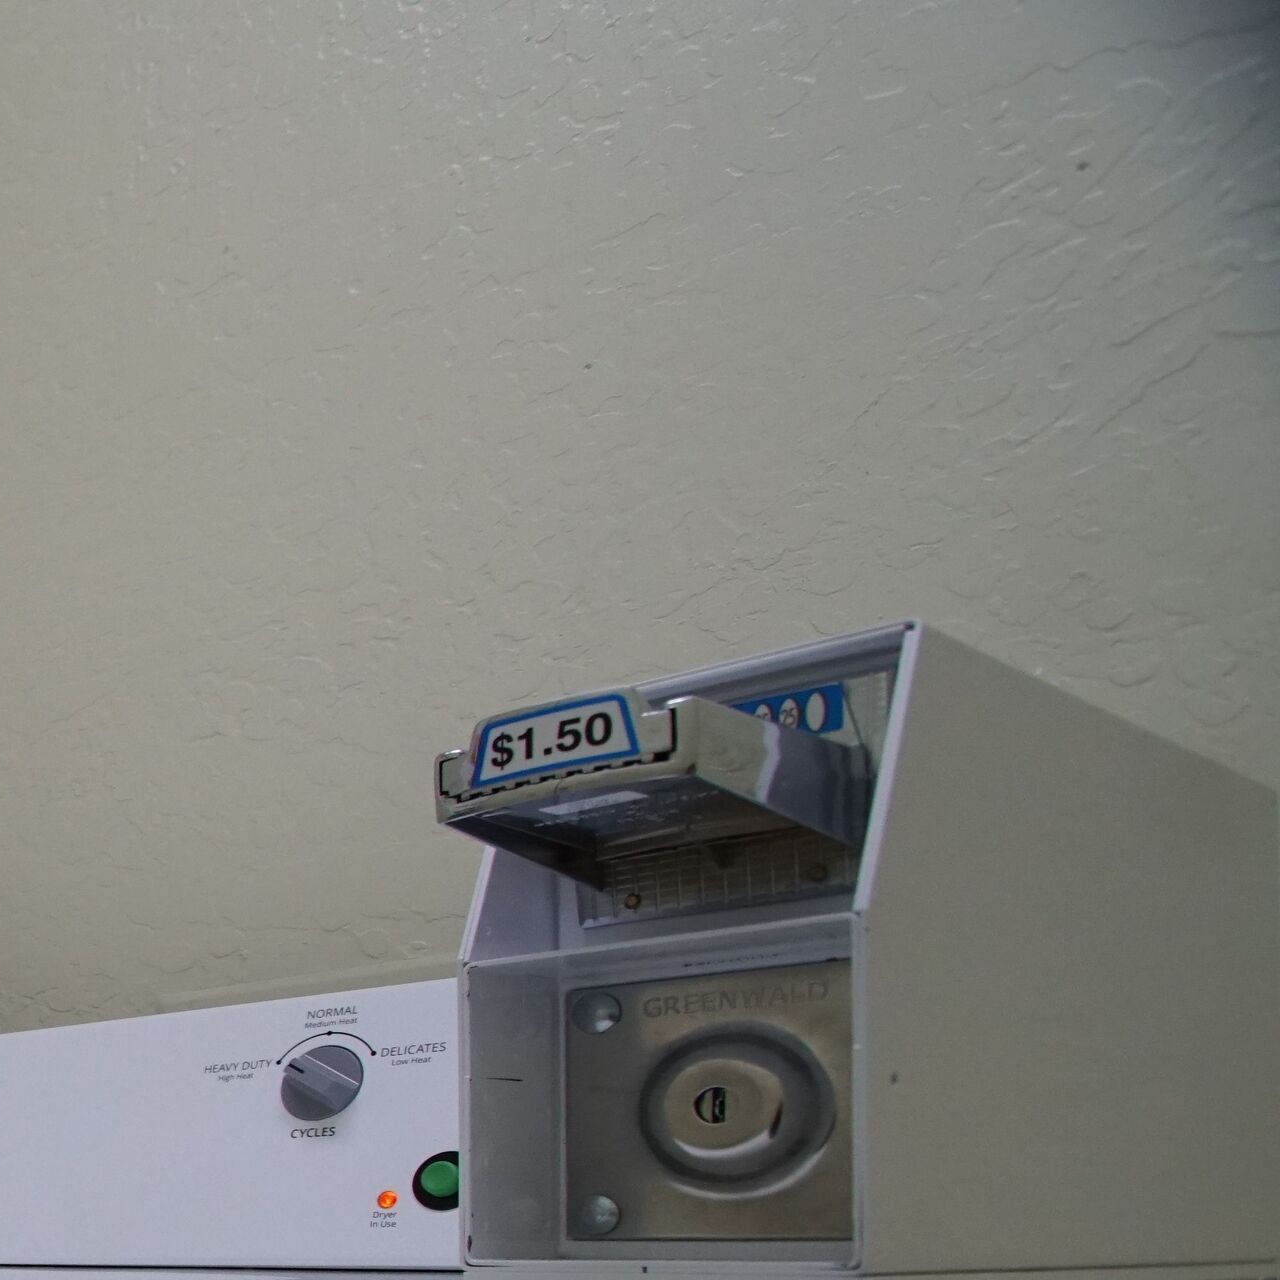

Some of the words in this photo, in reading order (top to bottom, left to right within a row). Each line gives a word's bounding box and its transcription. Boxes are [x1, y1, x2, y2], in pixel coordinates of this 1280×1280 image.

[491, 711, 613, 771] $1.50
[642, 979, 831, 1019] GREENWALD
[306, 1005, 359, 1019] NORMAL
[304, 1020, 337, 1029] Medium
[380, 1041, 447, 1058] DELICATES
[204, 1062, 240, 1074] HEAVY
[241, 1059, 272, 1071] DUTY
[391, 1058, 409, 1066] Low
[411, 1056, 432, 1064] Heat
[290, 1126, 336, 1139] CYCLES
[372, 1211, 398, 1220] Dryer
[369, 1220, 378, 1228] In
[380, 1220, 397, 1228] Use
